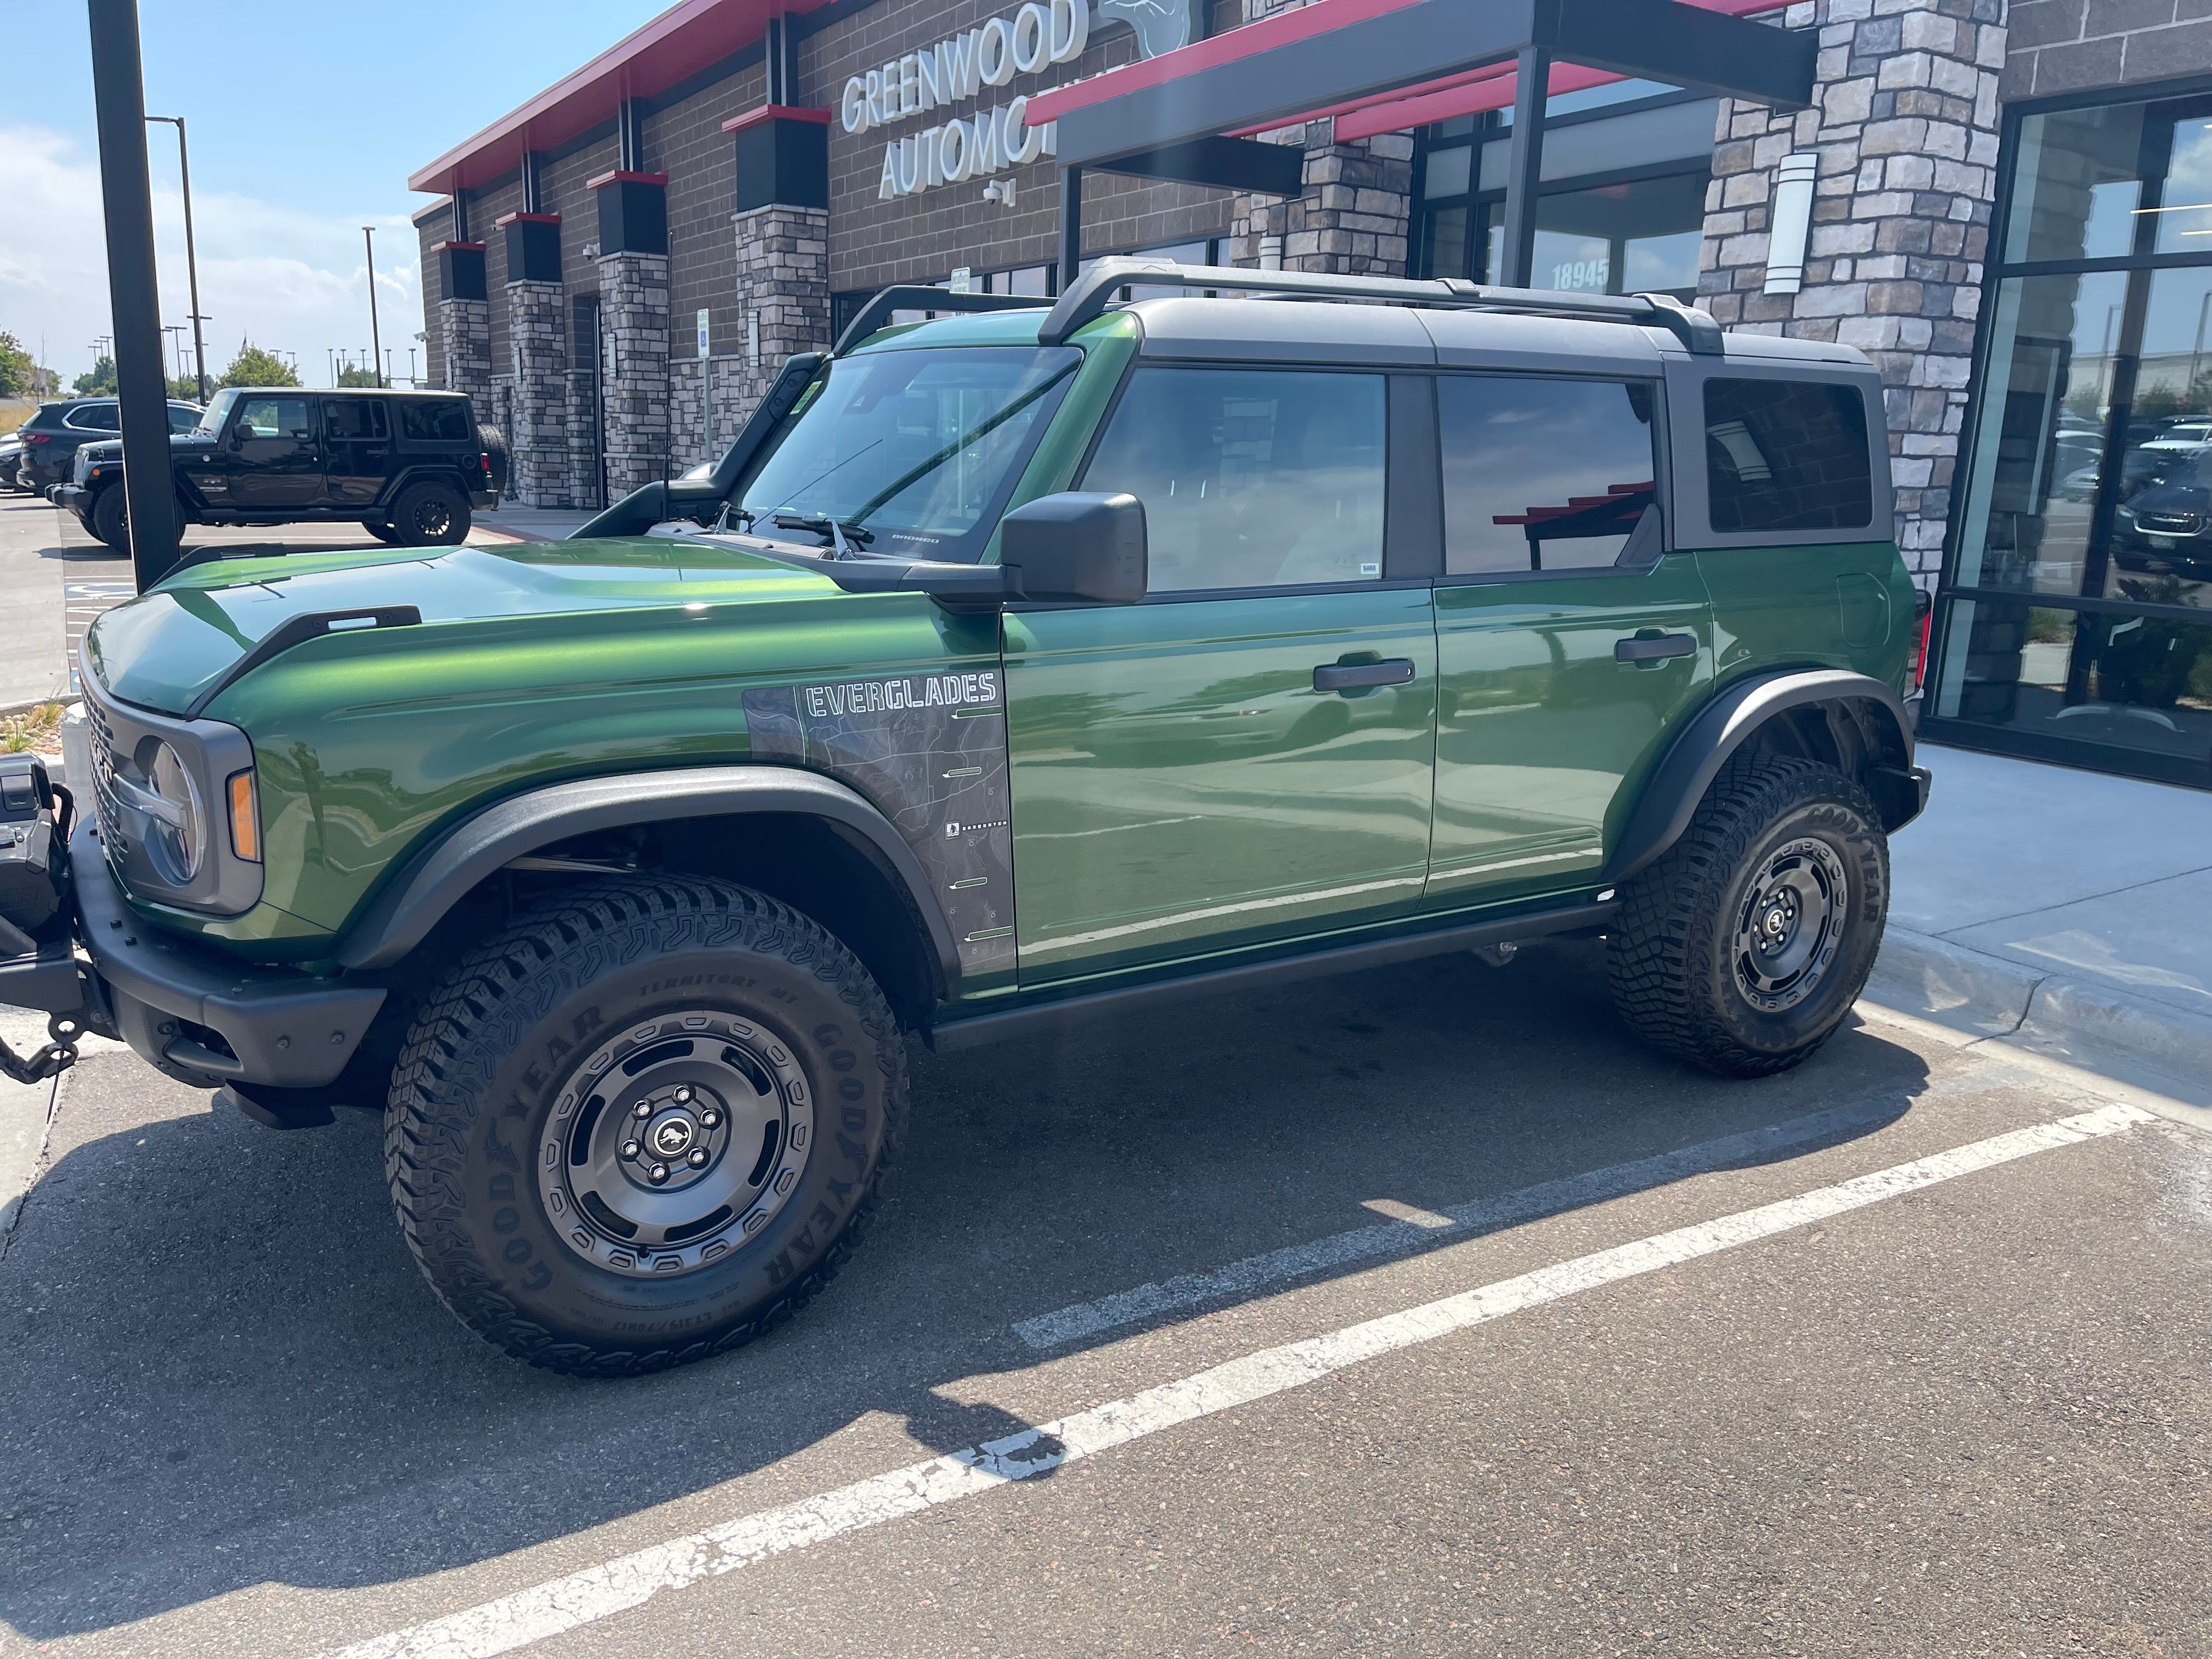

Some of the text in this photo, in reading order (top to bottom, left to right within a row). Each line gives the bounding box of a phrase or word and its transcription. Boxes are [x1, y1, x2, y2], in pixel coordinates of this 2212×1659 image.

[842, 0, 1089, 133] GREENWOOD
[1552, 258, 1610, 291] 18945
[892, 534, 940, 544] BRONCO
[805, 672, 997, 718] EVERGLADES
[489, 1005, 606, 1291] GOOD YEAR
[763, 1023, 867, 1286] GOOD YEAR
